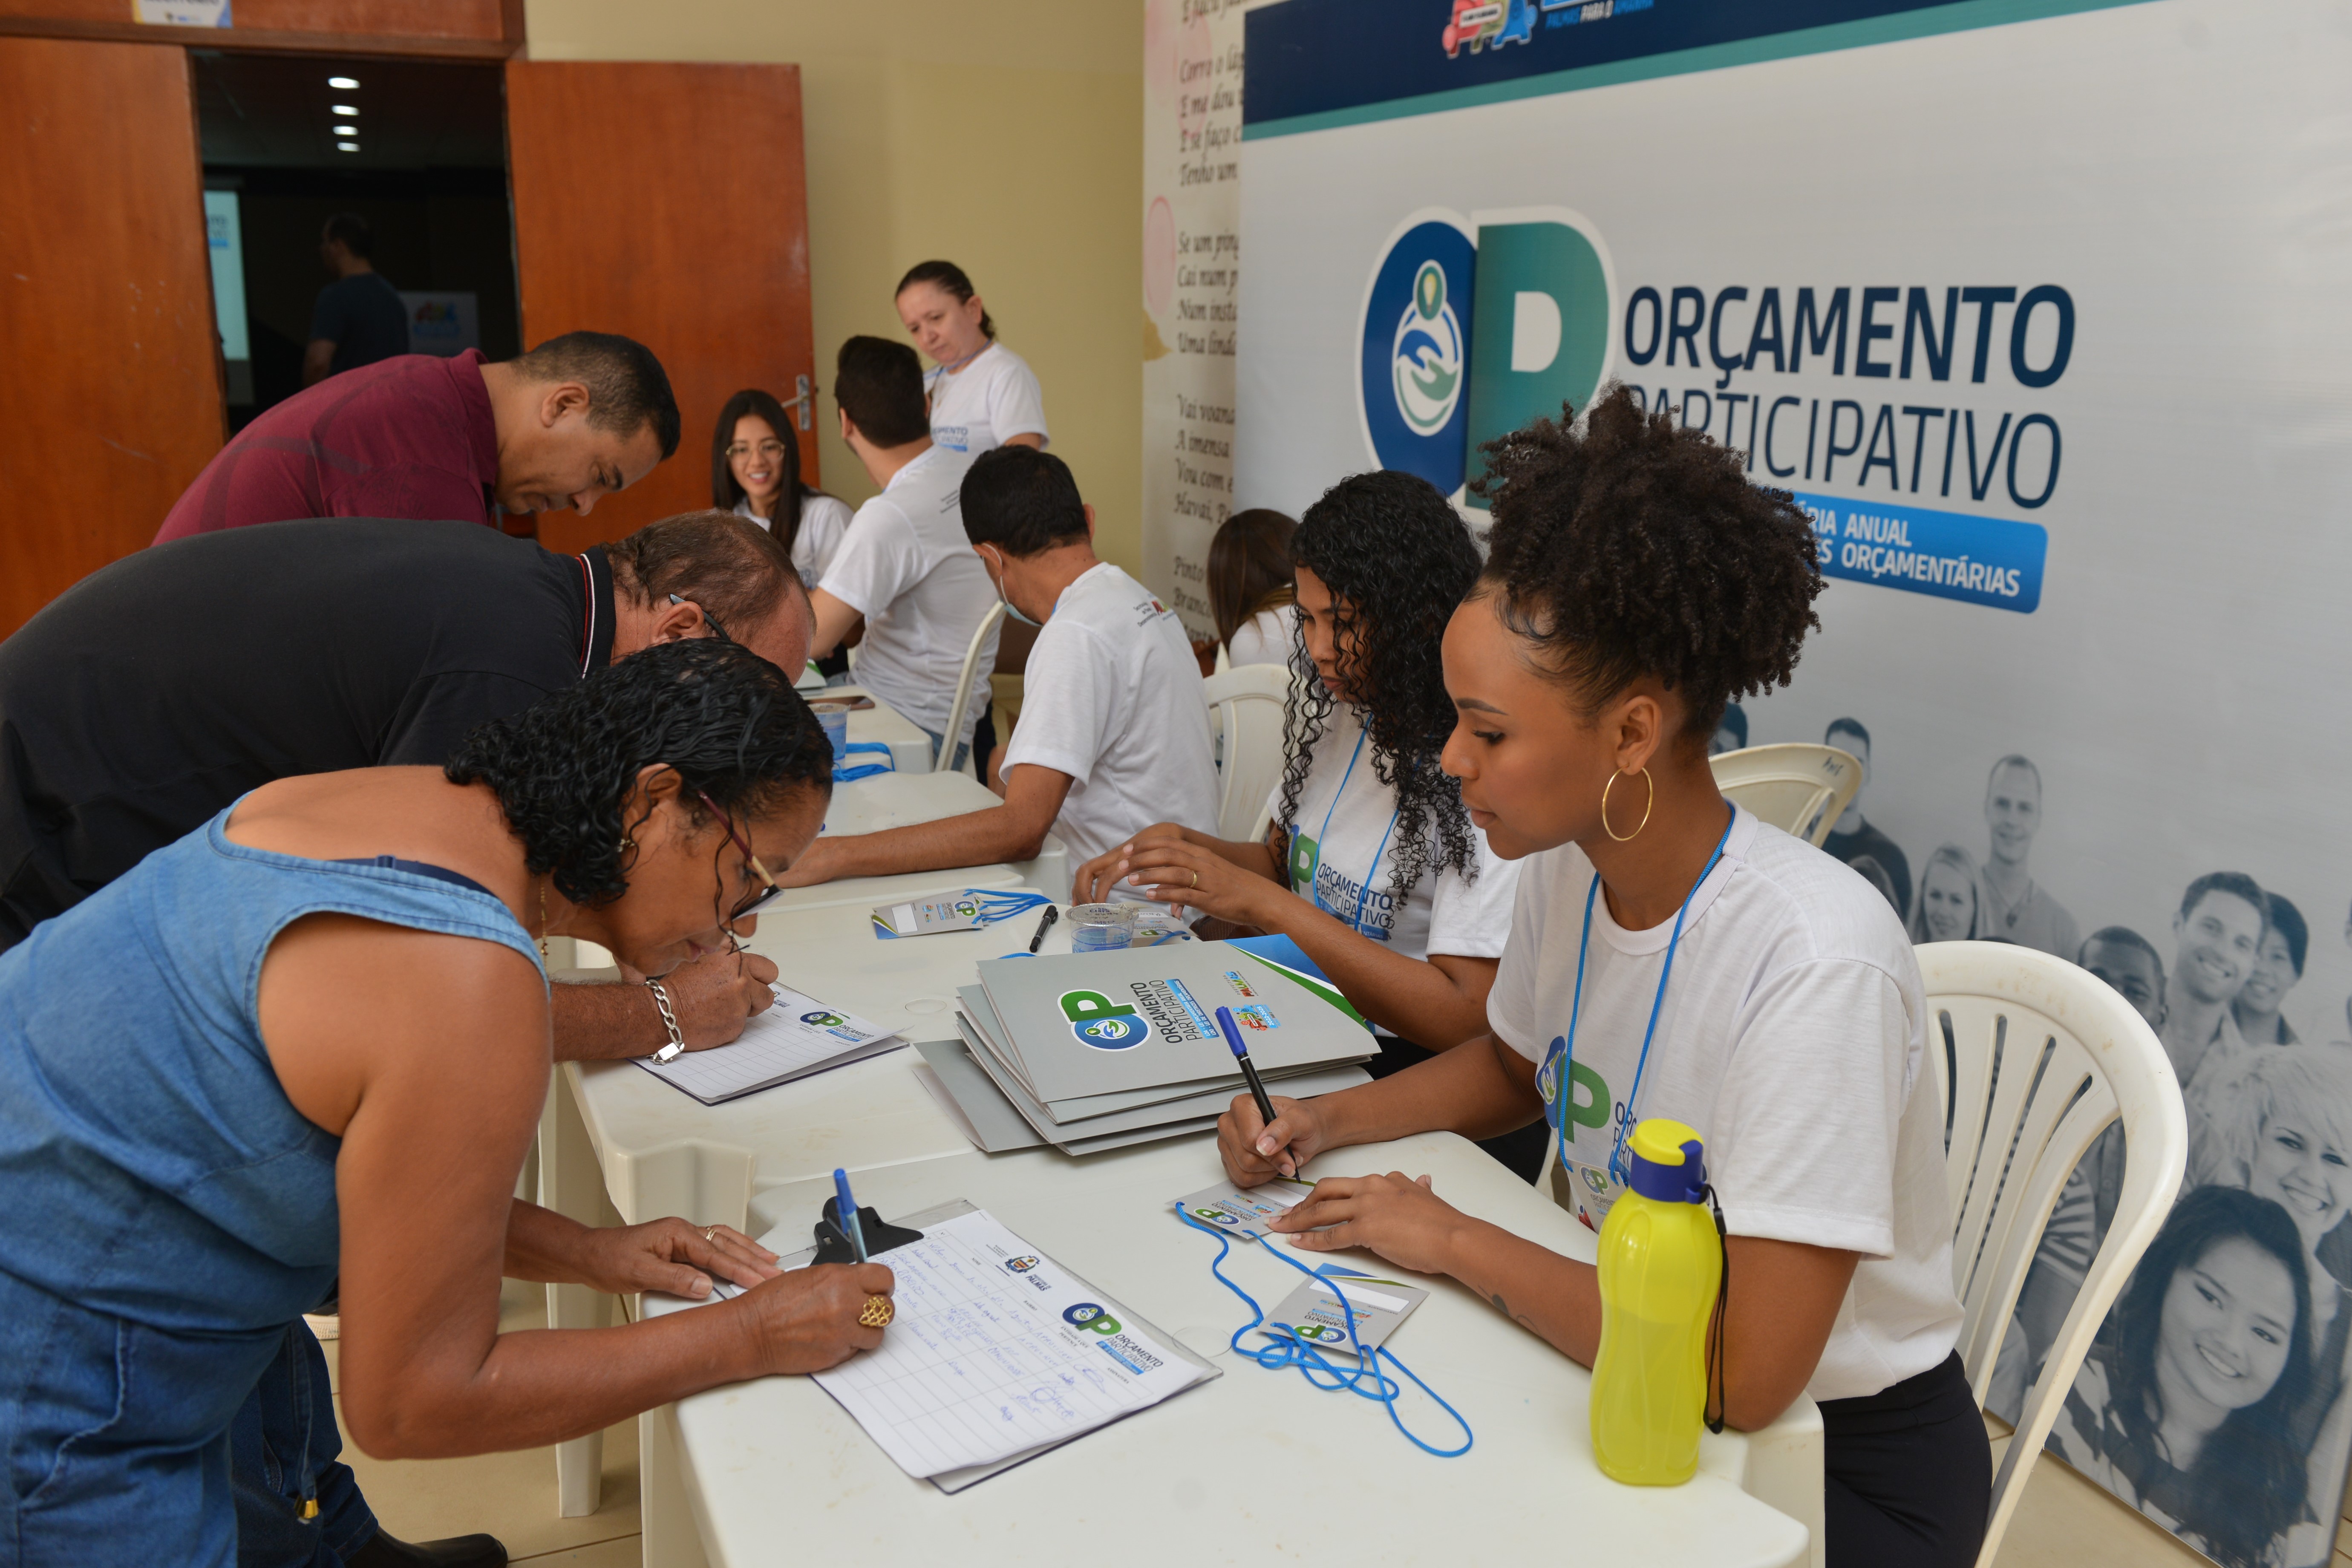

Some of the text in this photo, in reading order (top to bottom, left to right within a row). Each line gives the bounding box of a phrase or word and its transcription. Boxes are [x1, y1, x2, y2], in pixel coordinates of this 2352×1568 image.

[1625, 284, 2075, 389] ORÇAMENTO
[1843, 513, 1912, 548] ANUAL
[1841, 542, 2021, 597] ORÇAMENTÁRIAS
[1317, 863, 1393, 911] ORÇAMENTO
[1130, 983, 1183, 1043] ORÇAMENTO
[1149, 980, 1203, 1041] PARTICIPATIVO
[1257, 1006, 1275, 1026] 2022-2025
[1211, 1203, 1251, 1221] ORÇAMENTO
[1590, 1193, 1616, 1206] ORÇAMENT
[1025, 1275, 1048, 1291] PALMAS
[1304, 1315, 1356, 1330] RÇAMENTO
[1308, 1311, 1360, 1327] PTICIPATIVO
[1115, 1334, 1164, 1368] ORÇAMENTO
